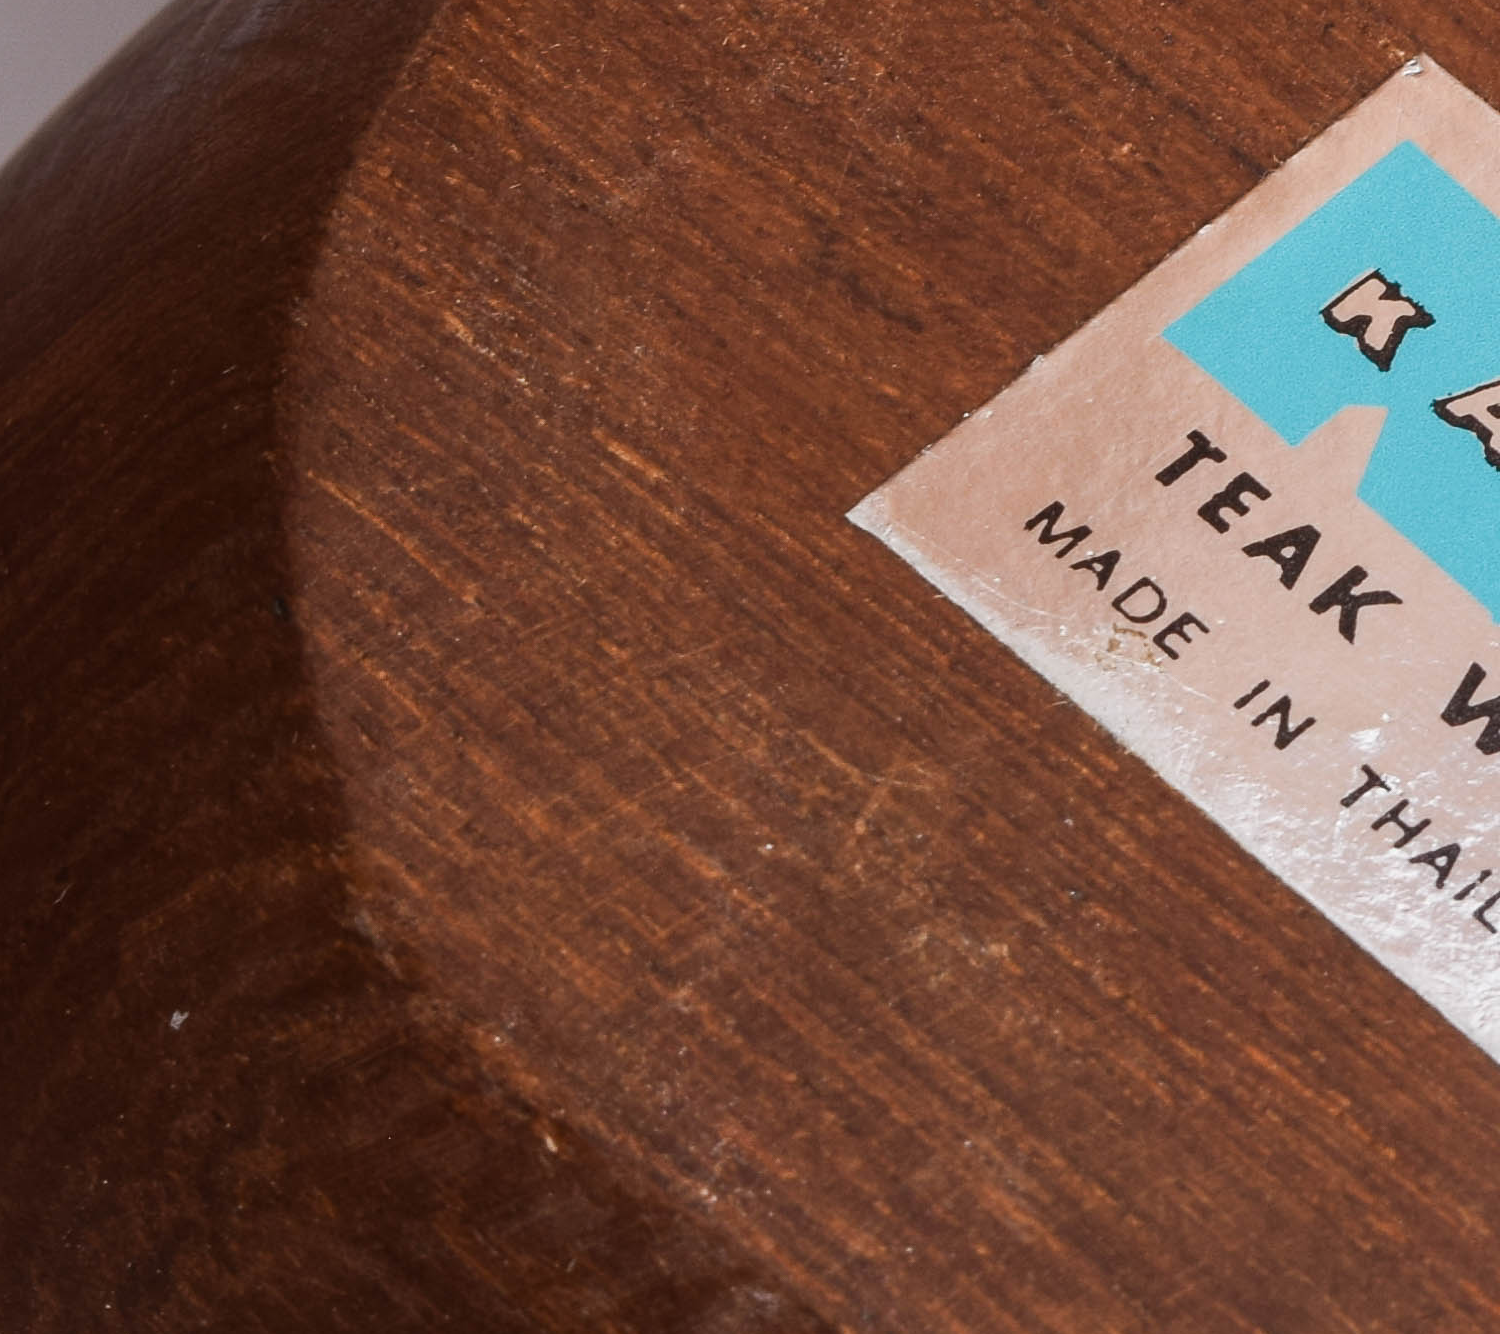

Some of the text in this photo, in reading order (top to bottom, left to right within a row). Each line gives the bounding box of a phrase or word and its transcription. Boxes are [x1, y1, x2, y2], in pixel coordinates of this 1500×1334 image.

[1024, 502, 1209, 661] MADE
[1233, 680, 1317, 748] IN
[1154, 431, 1402, 644] TEAK
